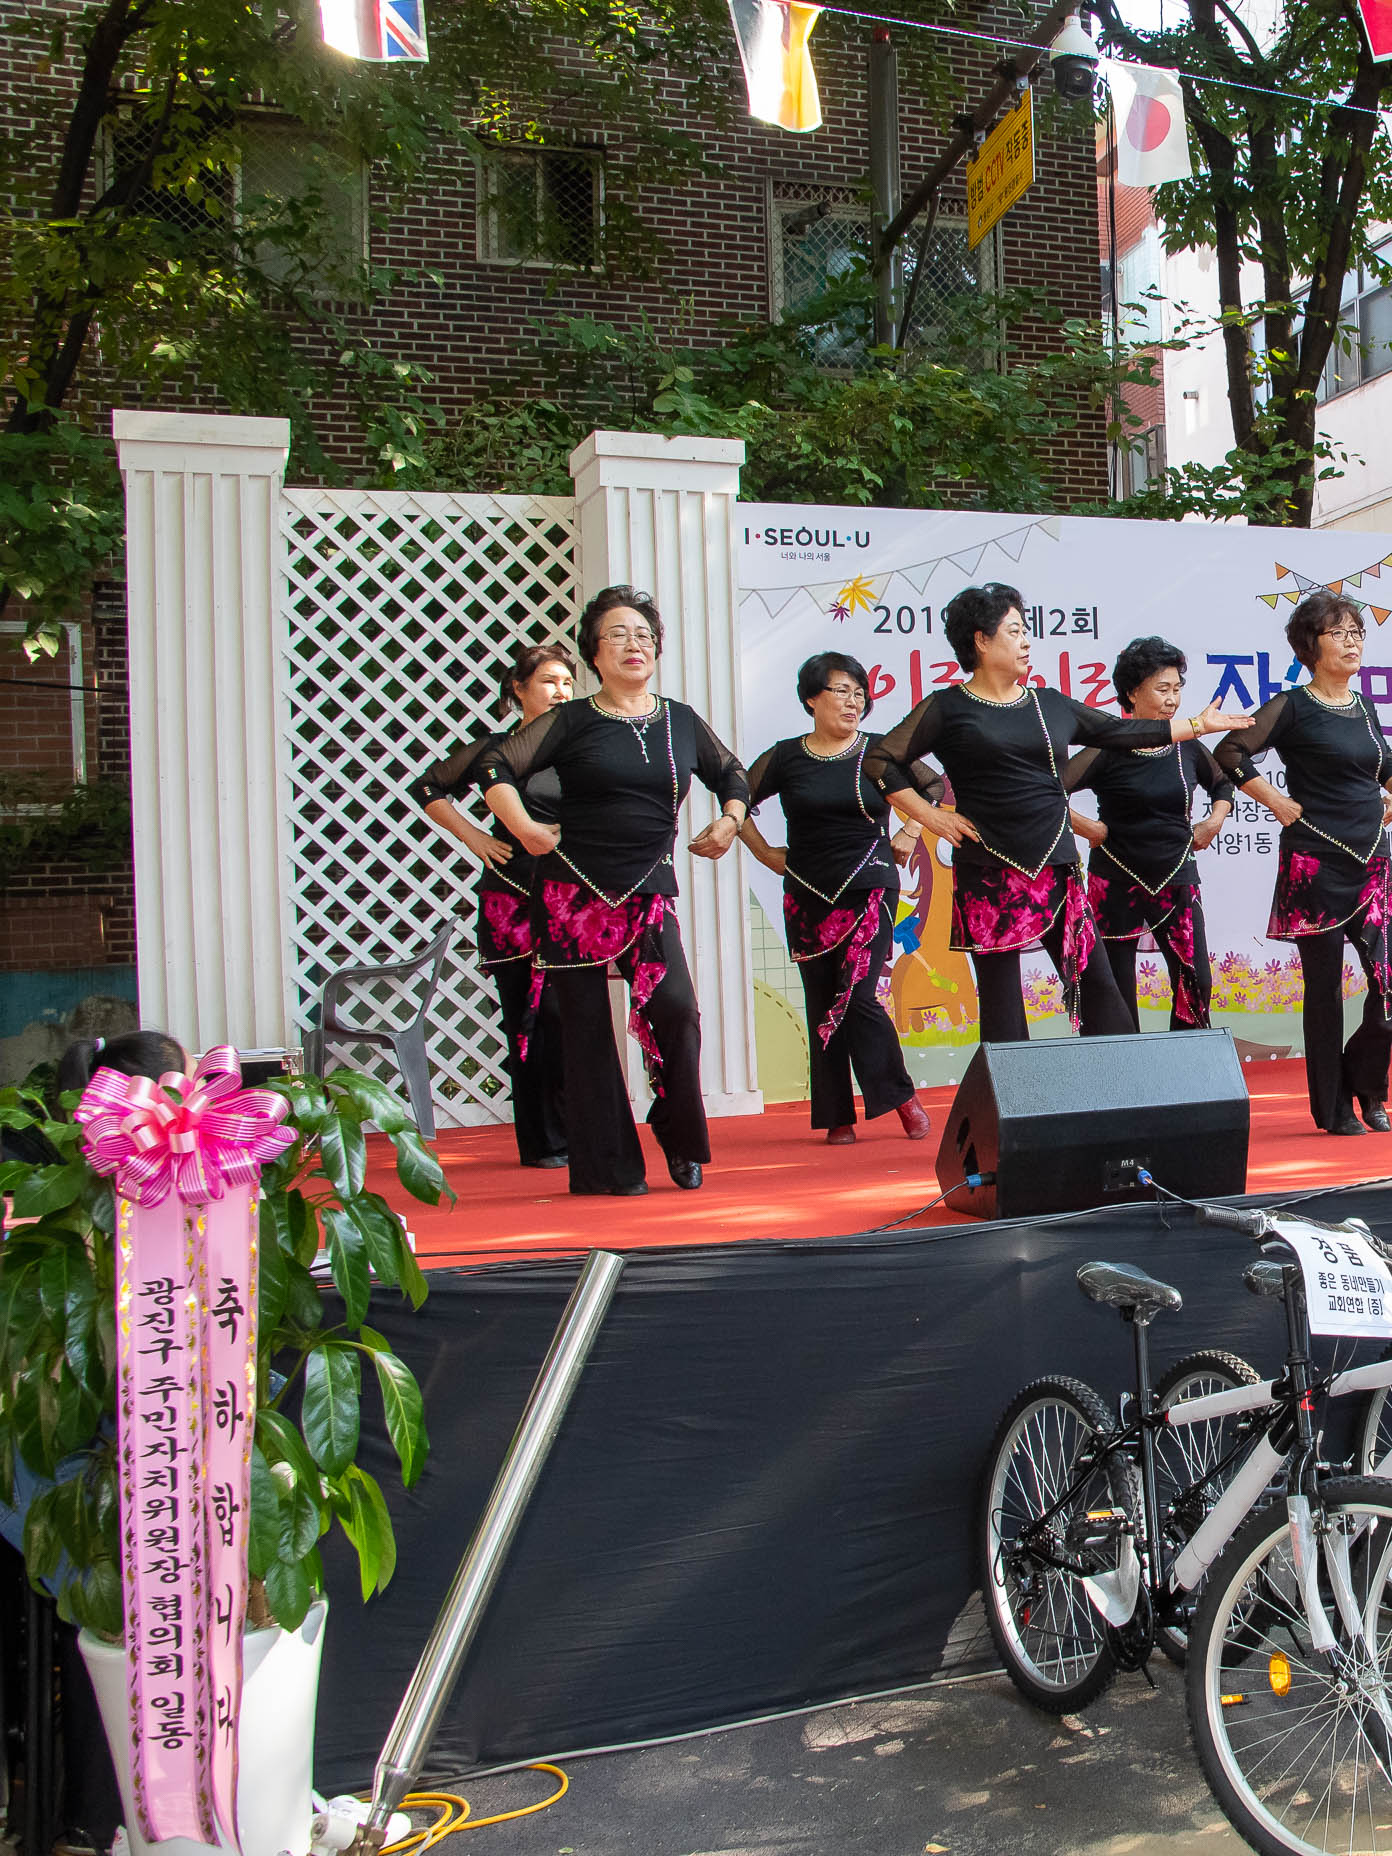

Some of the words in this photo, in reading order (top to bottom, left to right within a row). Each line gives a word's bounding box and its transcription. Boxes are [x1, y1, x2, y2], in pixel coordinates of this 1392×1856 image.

[970, 171, 984, 210] 방범
[985, 148, 1005, 193] CCTV
[1005, 119, 1029, 165] 작동중
[781, 552, 797, 561] 너와
[798, 552, 815, 561] 나의
[815, 553, 831, 562] 서울
[873, 604, 948, 635] 201
[1120, 1159, 1135, 1168] M4
[1318, 1272, 1337, 1290] 좋은
[1340, 1274, 1385, 1294] 동네만들기
[1327, 1294, 1365, 1314] 교회연합
[137, 1276, 185, 1367] 광진구
[137, 1374, 191, 1586] 주민자치위원장
[145, 1593, 184, 1682] 협의회
[148, 1691, 193, 1750] 일동
